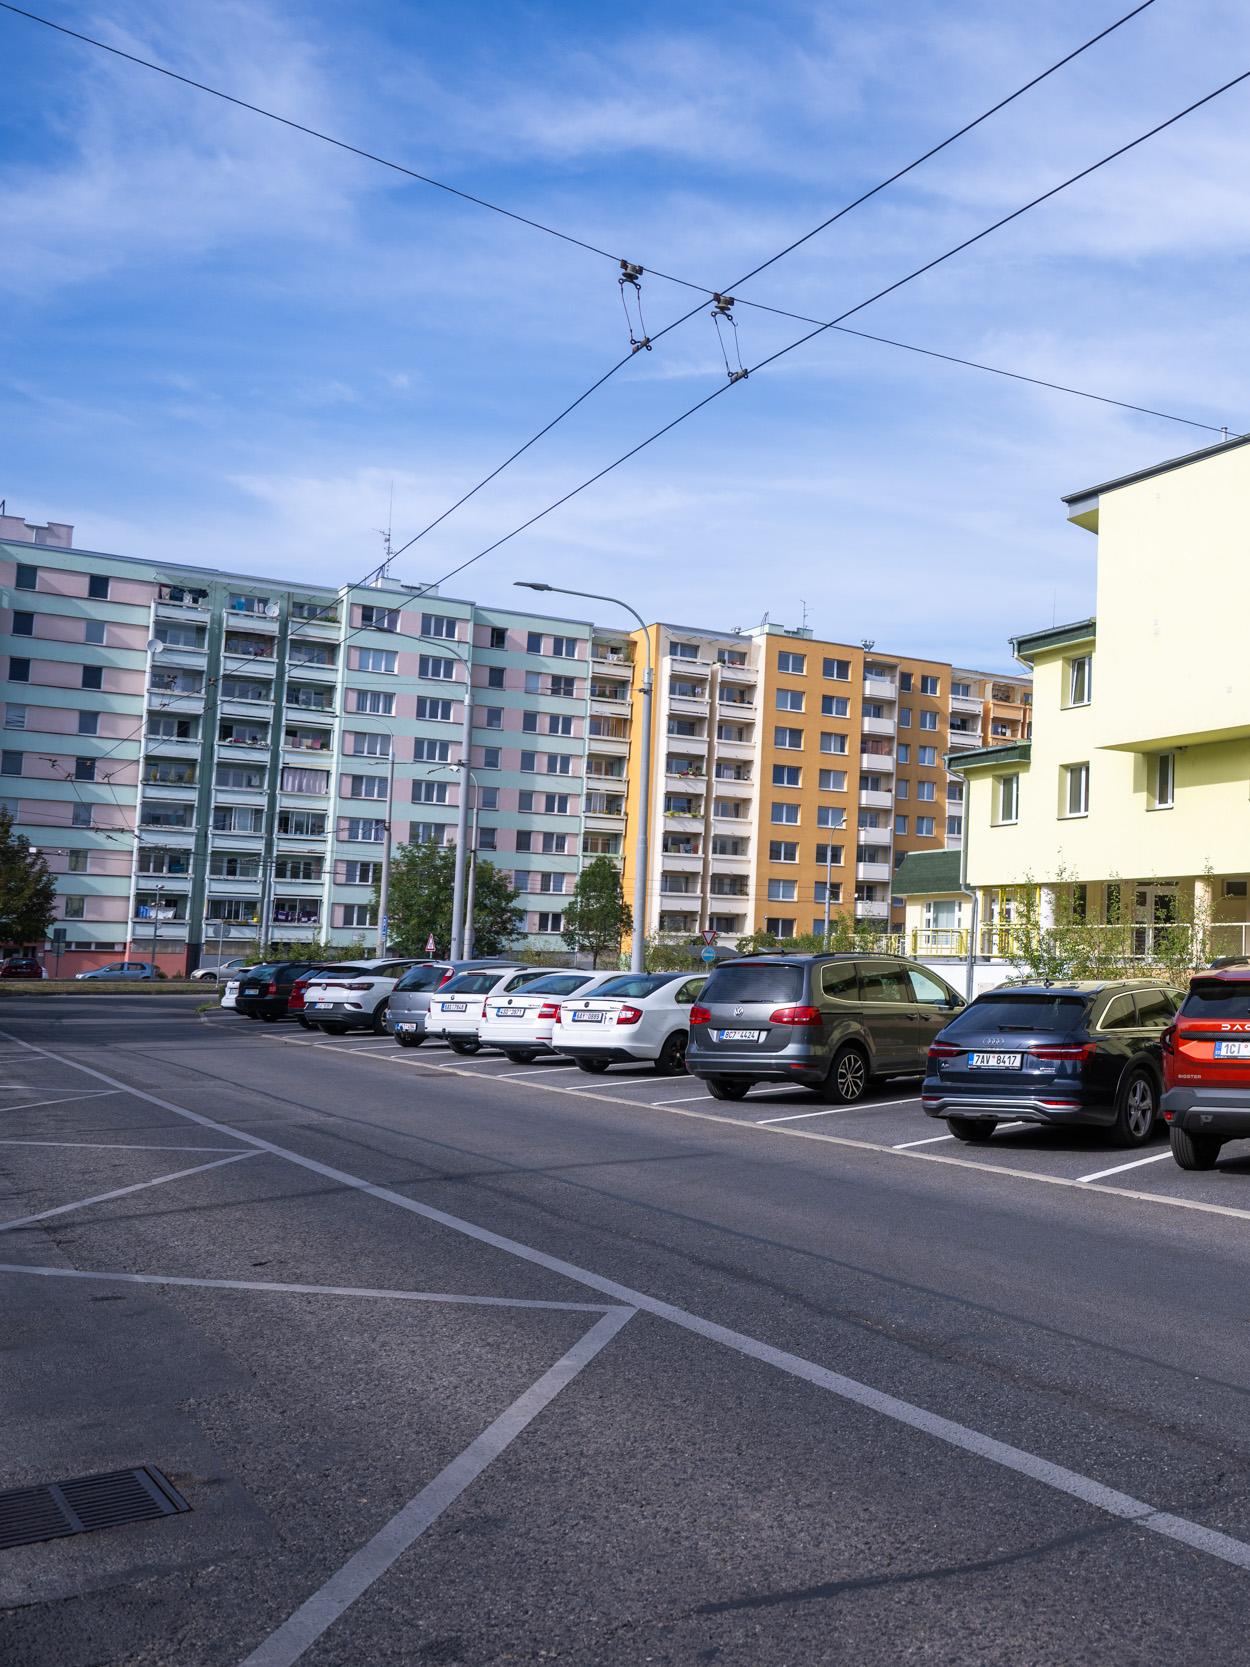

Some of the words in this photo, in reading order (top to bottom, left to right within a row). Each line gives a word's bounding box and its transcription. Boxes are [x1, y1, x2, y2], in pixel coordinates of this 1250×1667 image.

[740, 1031, 755, 1039] 4424
[1224, 1043, 1241, 1054] 1CI
[975, 1054, 991, 1065] 7AV
[996, 1055, 1017, 1065] 8417
